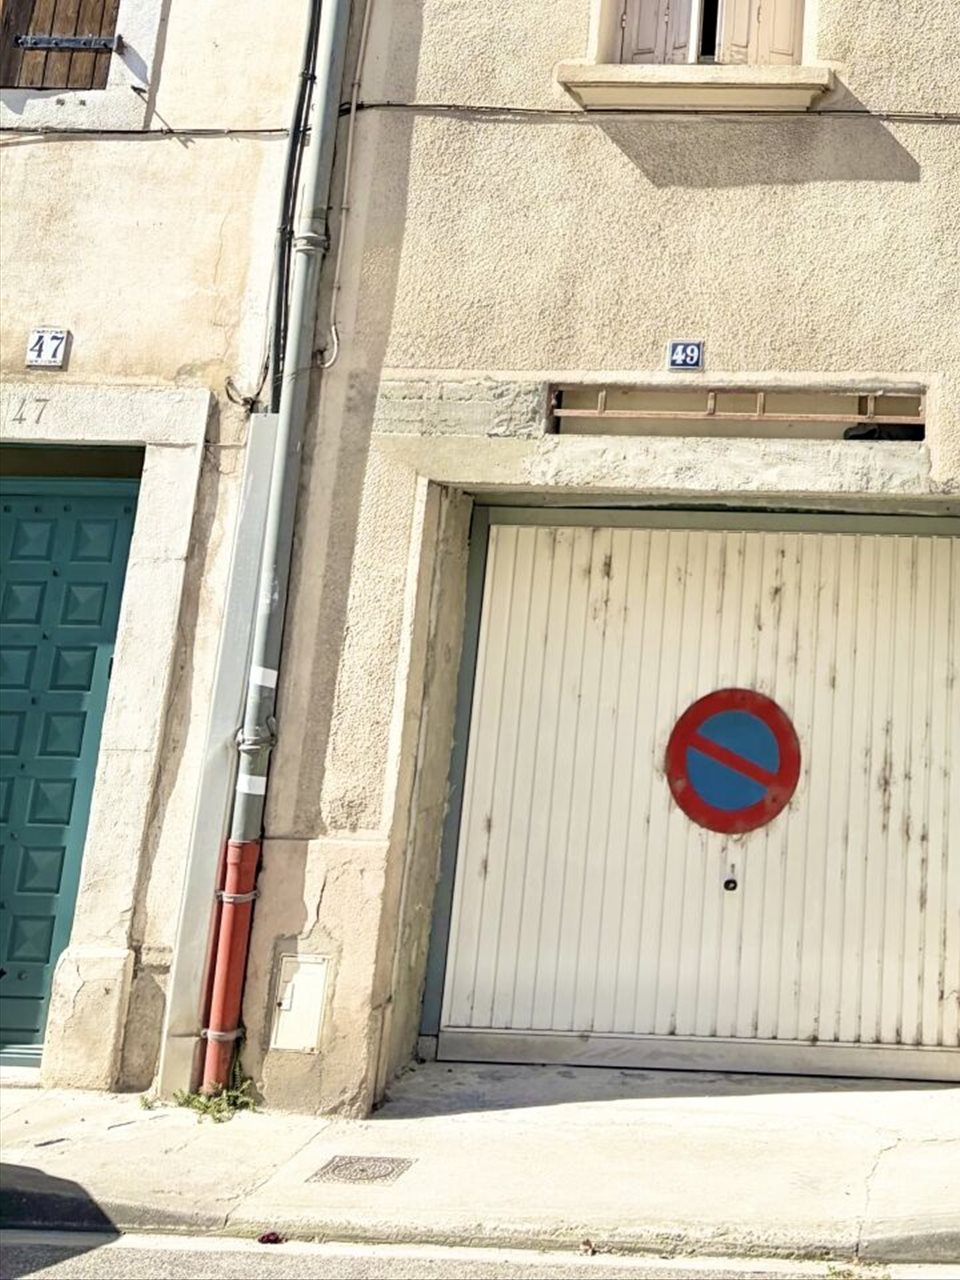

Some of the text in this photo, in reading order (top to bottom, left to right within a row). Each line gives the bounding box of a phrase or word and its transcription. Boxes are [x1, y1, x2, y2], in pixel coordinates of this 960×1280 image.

[29, 335, 65, 359] 47
[672, 344, 699, 365] 49
[12, 398, 50, 424] 47
